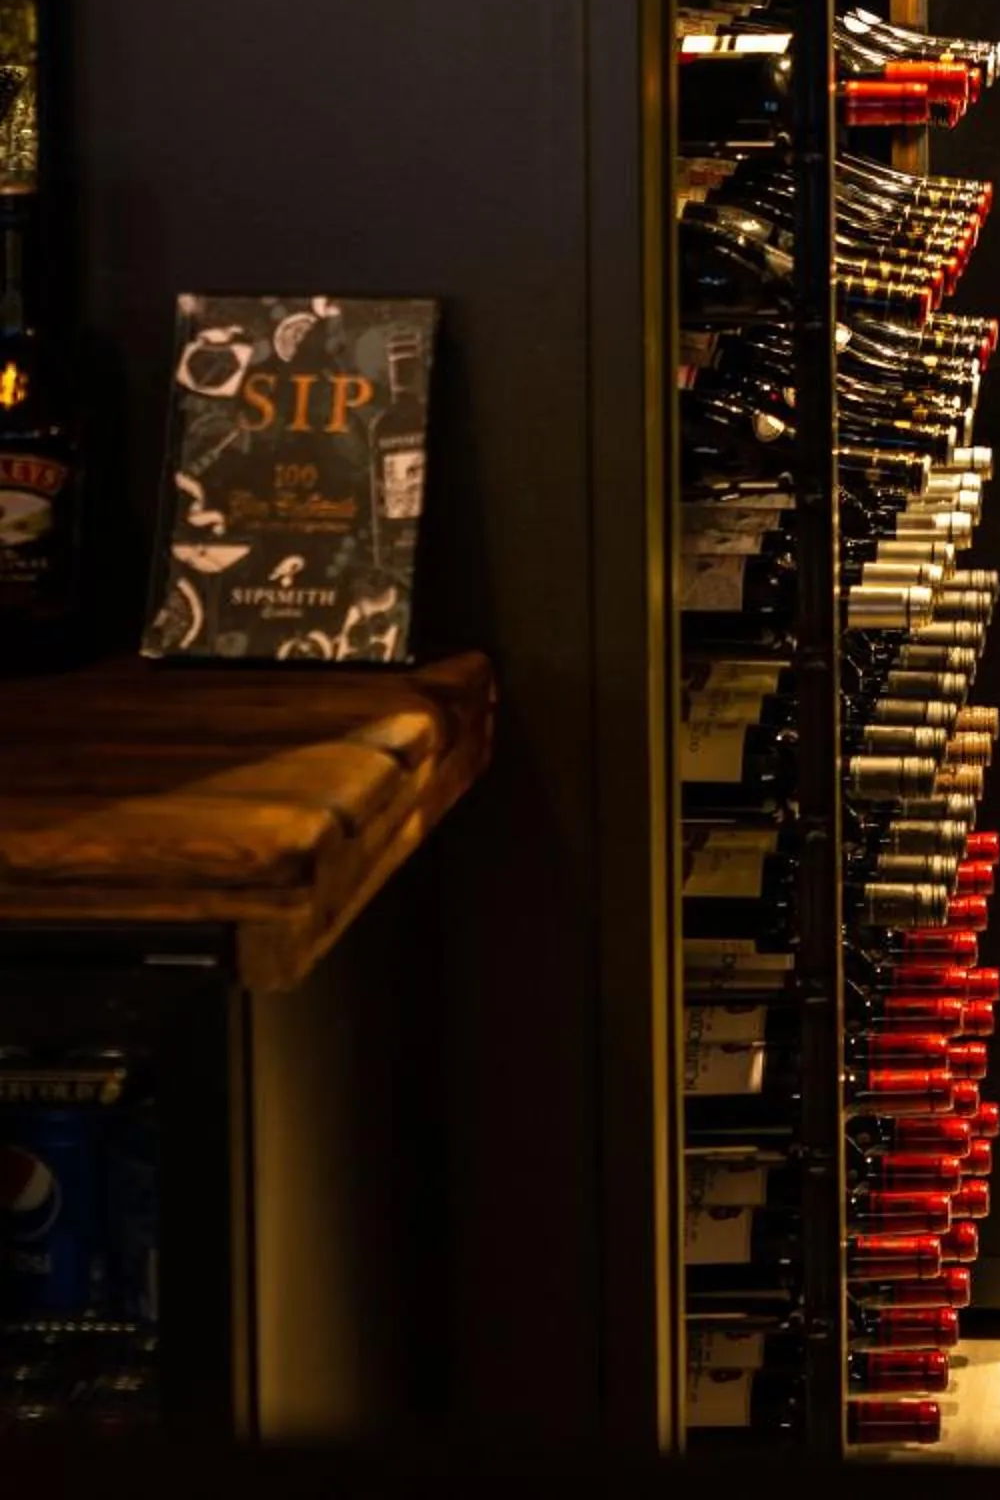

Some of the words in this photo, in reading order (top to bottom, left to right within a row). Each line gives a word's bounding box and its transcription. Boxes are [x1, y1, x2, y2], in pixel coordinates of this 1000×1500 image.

[240, 371, 375, 433] SIP
[274, 464, 319, 488] 100
[230, 586, 336, 607] SIPSMITH
